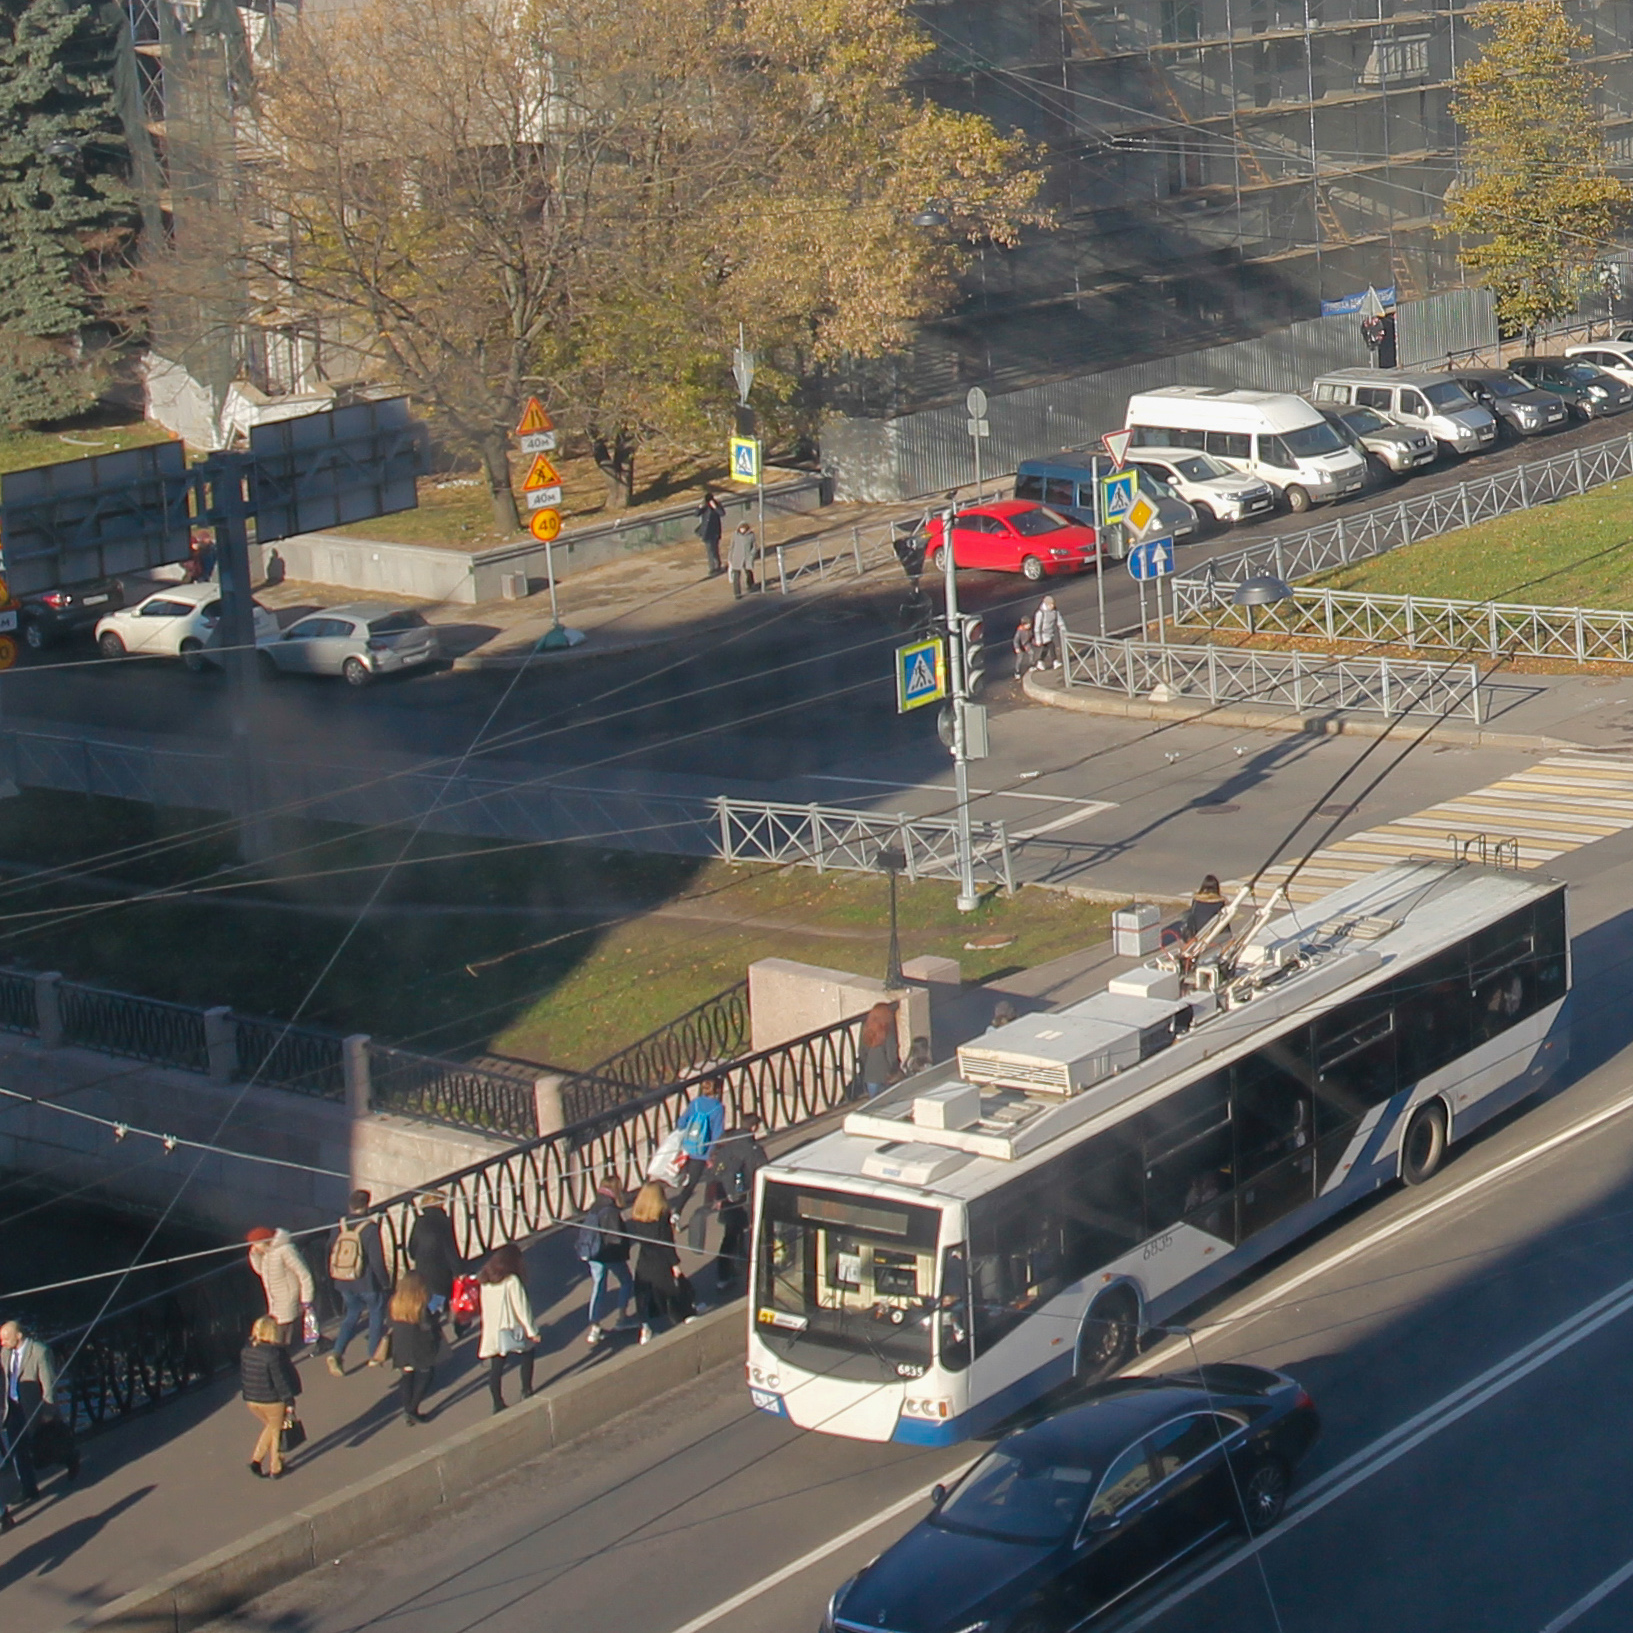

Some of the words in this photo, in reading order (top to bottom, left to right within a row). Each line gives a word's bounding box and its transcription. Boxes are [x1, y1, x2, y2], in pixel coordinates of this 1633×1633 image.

[538, 517, 557, 531] 40
[1143, 1235, 1174, 1261] 6835
[897, 1363, 924, 1377] 6835
